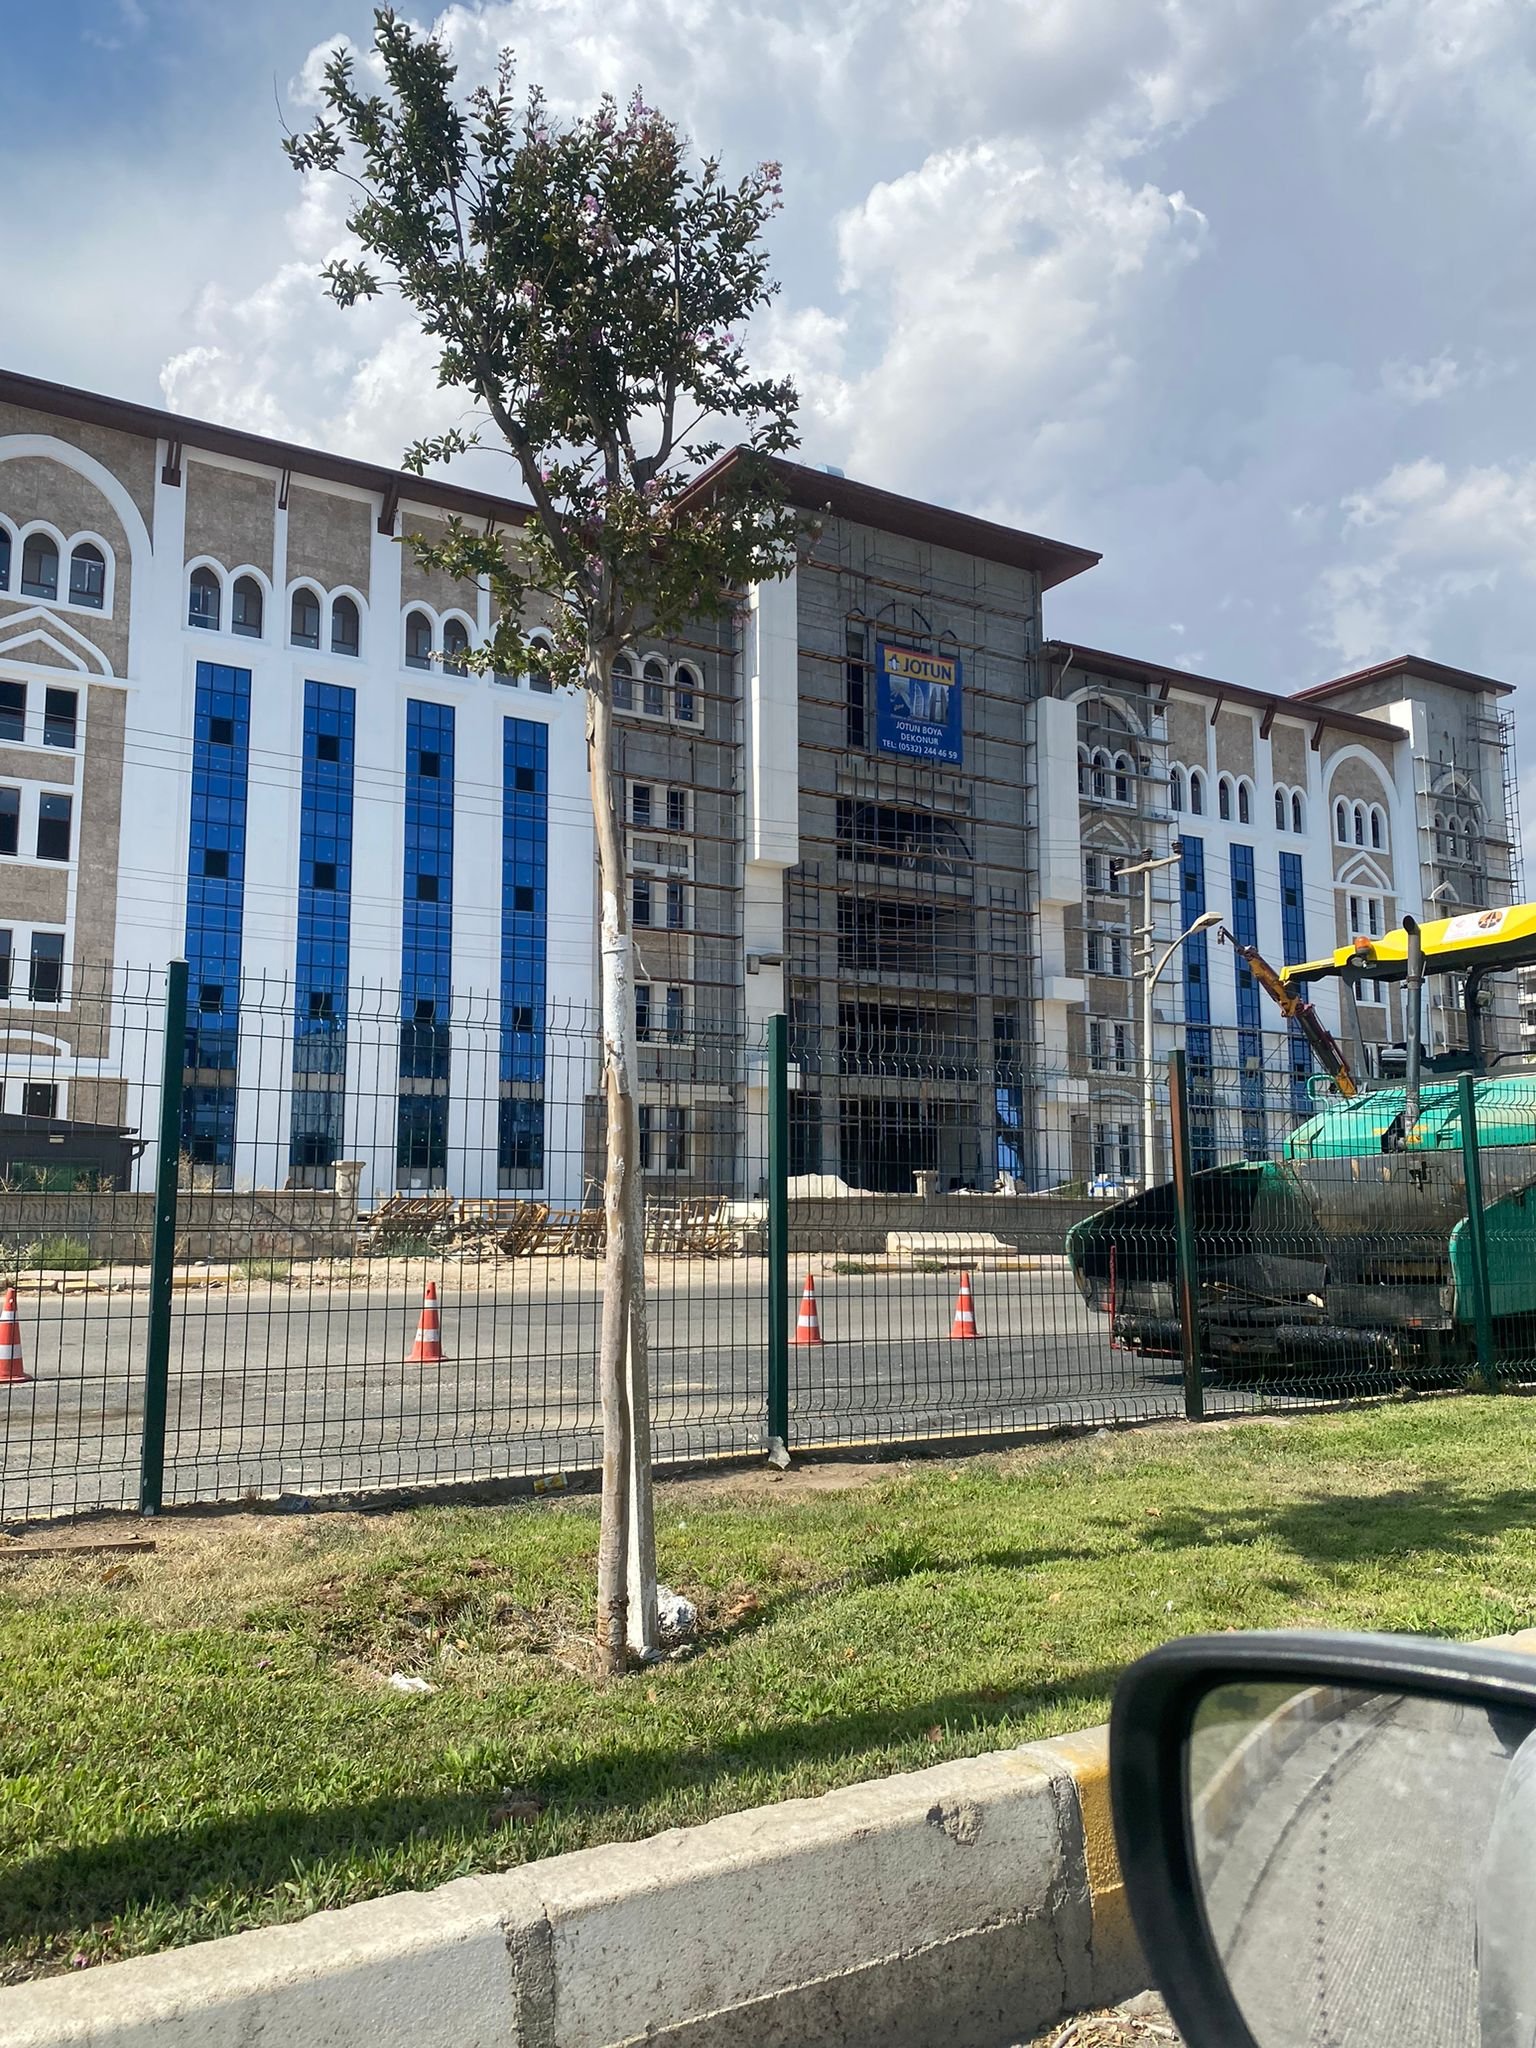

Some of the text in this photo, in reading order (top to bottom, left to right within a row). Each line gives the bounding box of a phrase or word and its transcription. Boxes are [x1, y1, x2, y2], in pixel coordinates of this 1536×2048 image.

[903, 657, 952, 681] JOTUN
[896, 721, 943, 737] JOTUN BOYA
[900, 732, 939, 745] DEKONUR
[882, 739, 958, 760] TEL: (0532) 244 46 59
